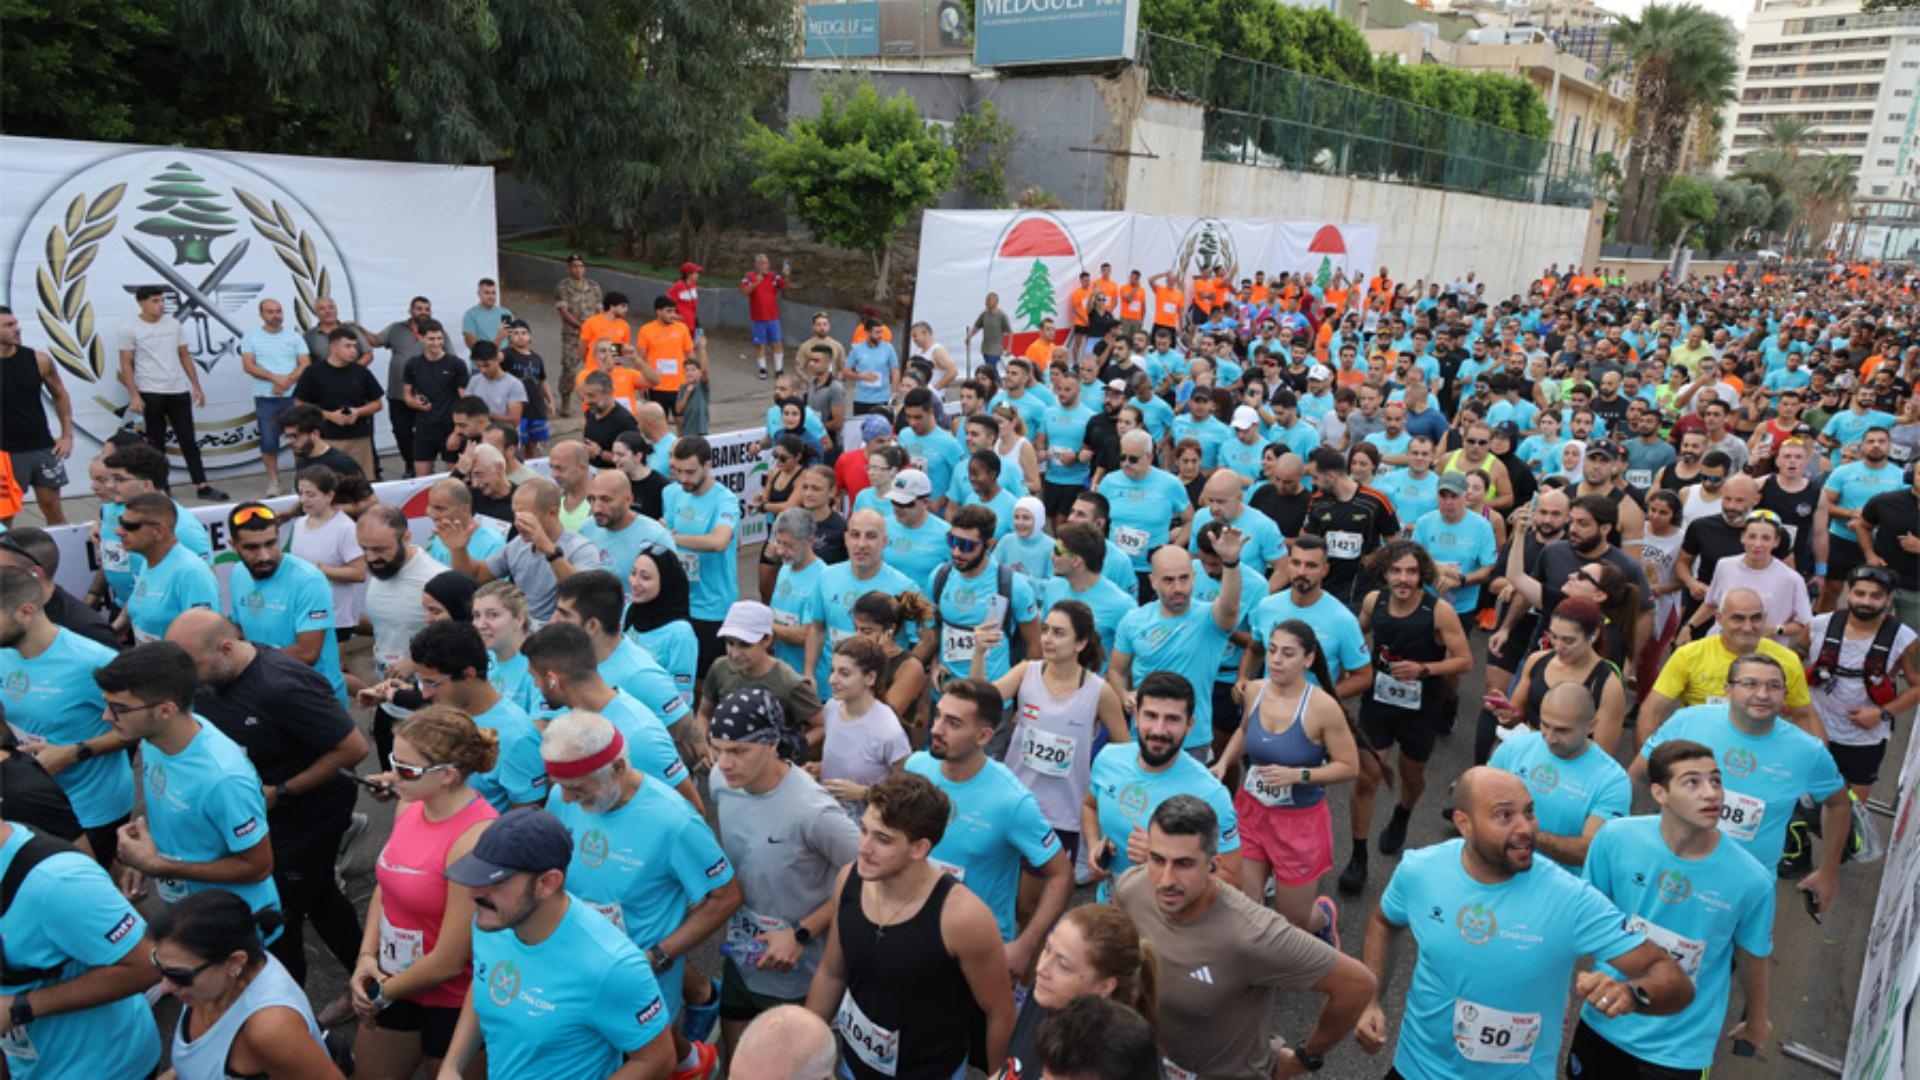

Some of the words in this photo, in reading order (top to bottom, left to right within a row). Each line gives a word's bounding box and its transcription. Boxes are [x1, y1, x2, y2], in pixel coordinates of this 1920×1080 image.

[710, 440, 764, 469] BANESE
[948, 636, 976, 651] 143
[1387, 686, 1407, 699] 93
[1028, 740, 1066, 764] 1220
[846, 1012, 887, 1058] 1044
[1478, 1026, 1512, 1047] 50
